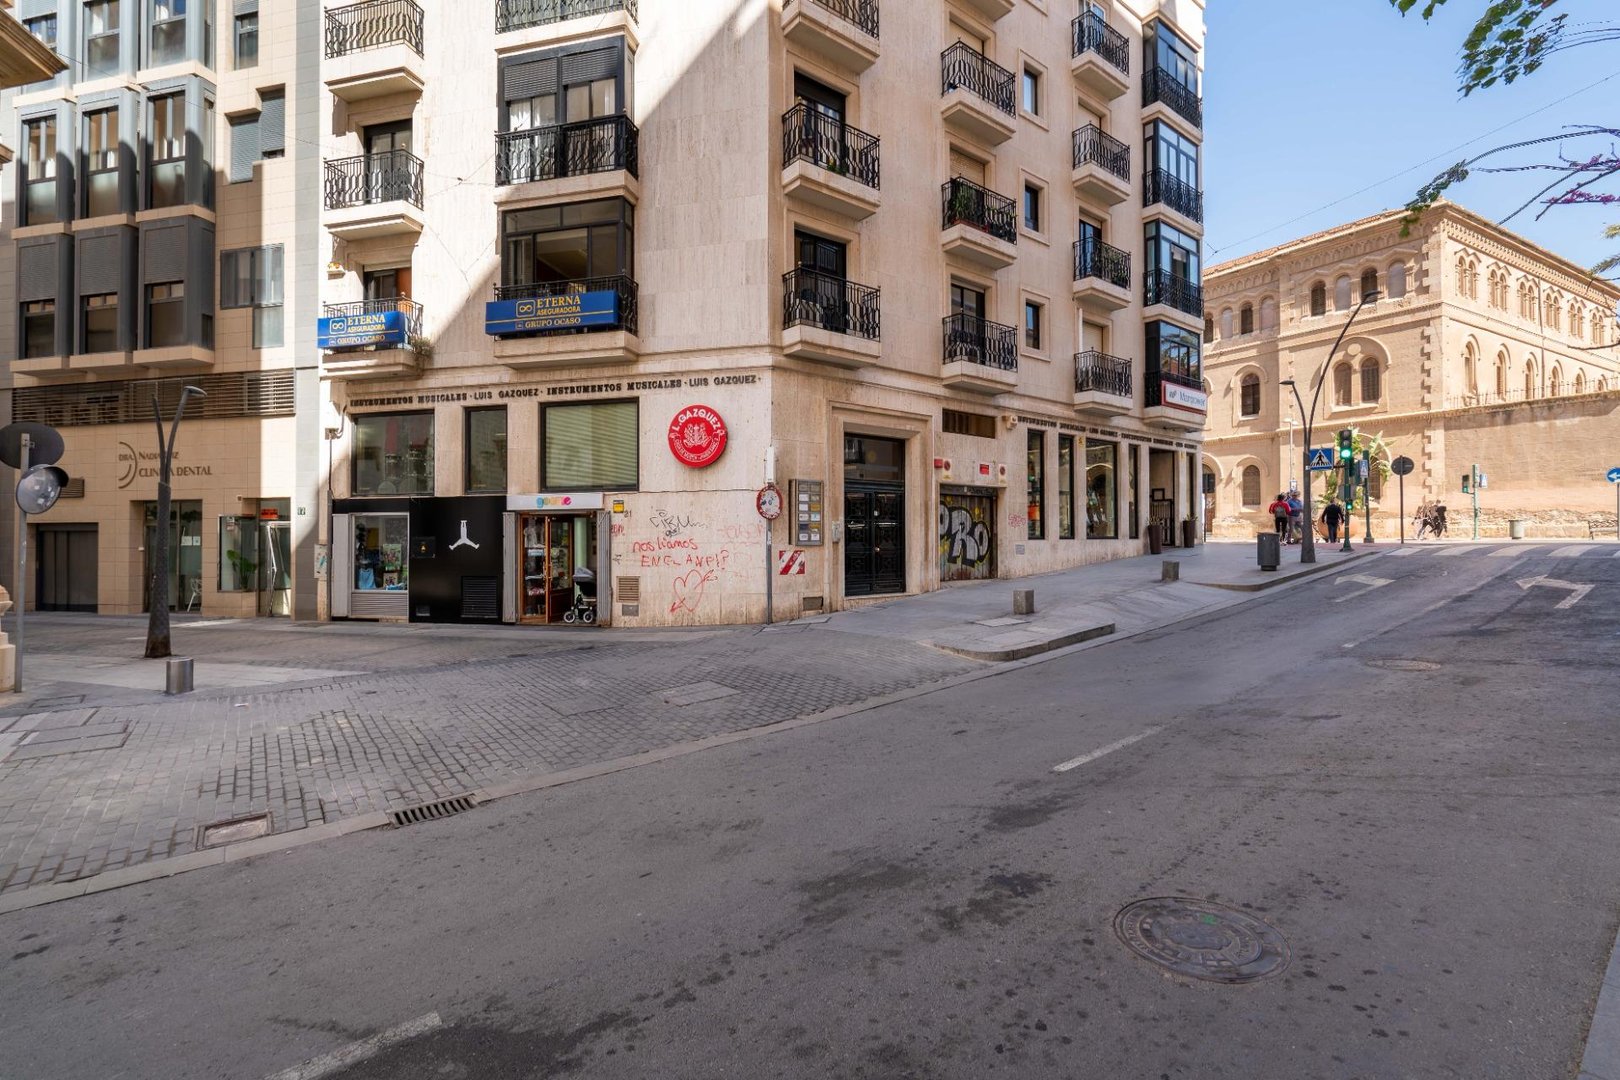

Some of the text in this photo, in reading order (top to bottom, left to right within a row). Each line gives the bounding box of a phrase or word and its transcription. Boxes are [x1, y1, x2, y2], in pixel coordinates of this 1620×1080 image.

[537, 295, 581, 308] ETERNA
[537, 305, 581, 316] ASEGURADORA
[347, 314, 386, 326] ETERNA
[525, 317, 581, 329] GRUPO OCASO
[337, 334, 386, 345] GRUPO OCASO
[417, 392, 468, 404] MUSICALES
[474, 391, 493, 400] LUIS
[498, 388, 539, 399] GAZQUEZ
[547, 383, 622, 396] INSTRUMENTOS
[627, 378, 682, 391] MUSICALES
[689, 378, 709, 387] LUIS
[714, 375, 757, 386] GAZQUEZ
[176, 466, 213, 477] DENTAL
